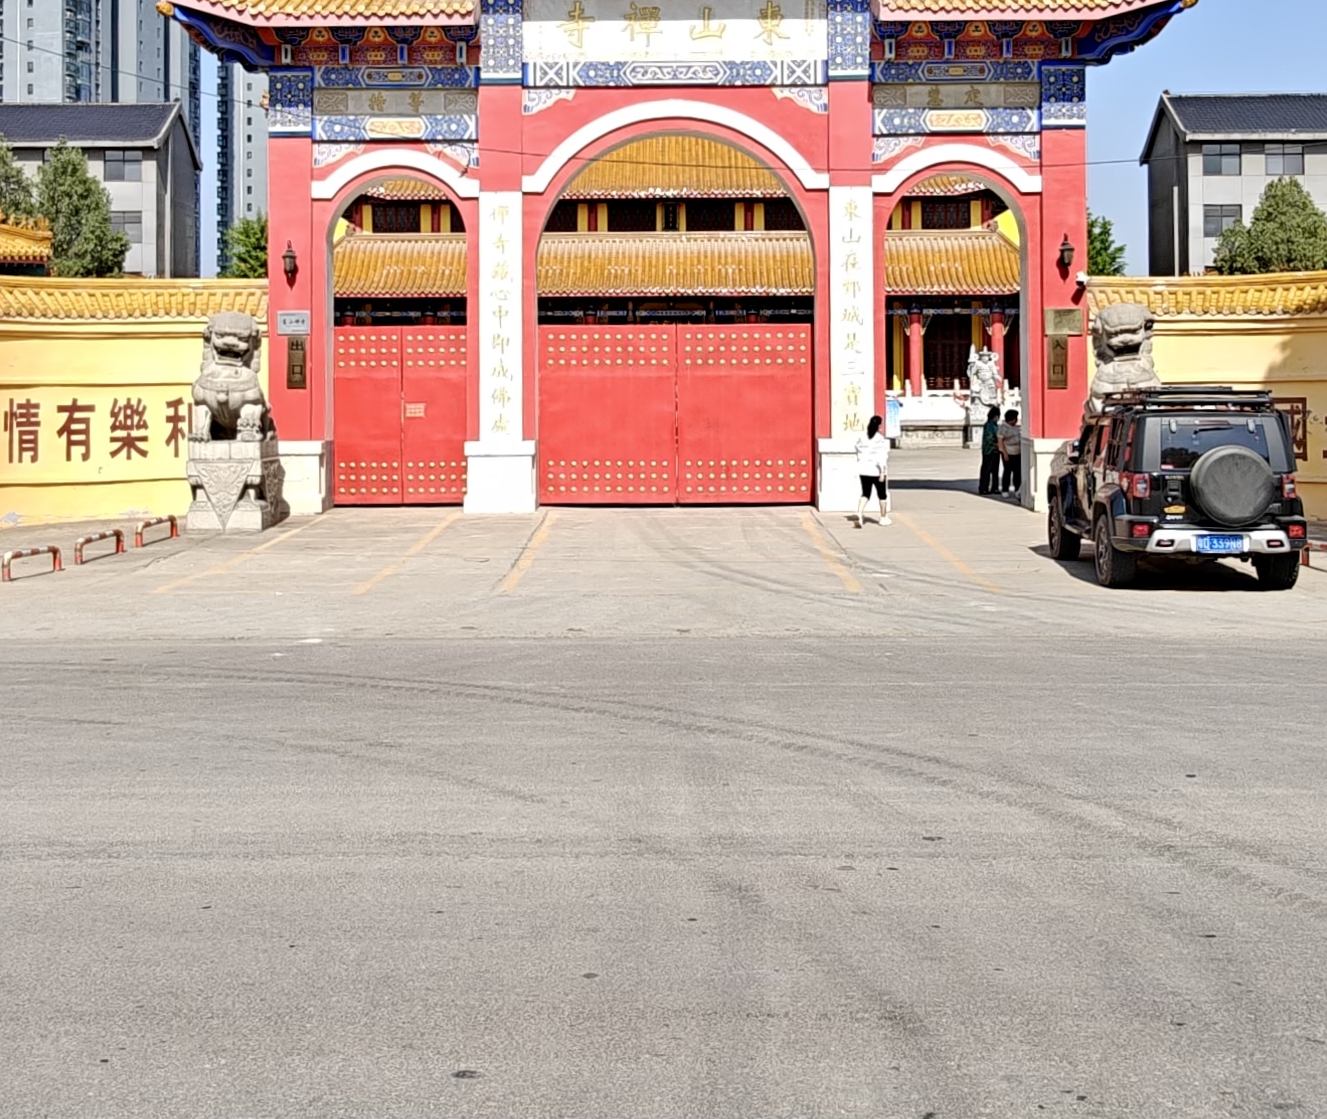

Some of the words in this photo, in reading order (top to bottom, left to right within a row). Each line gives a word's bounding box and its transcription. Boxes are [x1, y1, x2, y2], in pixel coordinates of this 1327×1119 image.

[556, 0, 791, 49] 東山禪寺
[290, 339, 304, 376] 出口
[1052, 339, 1066, 376] 入口
